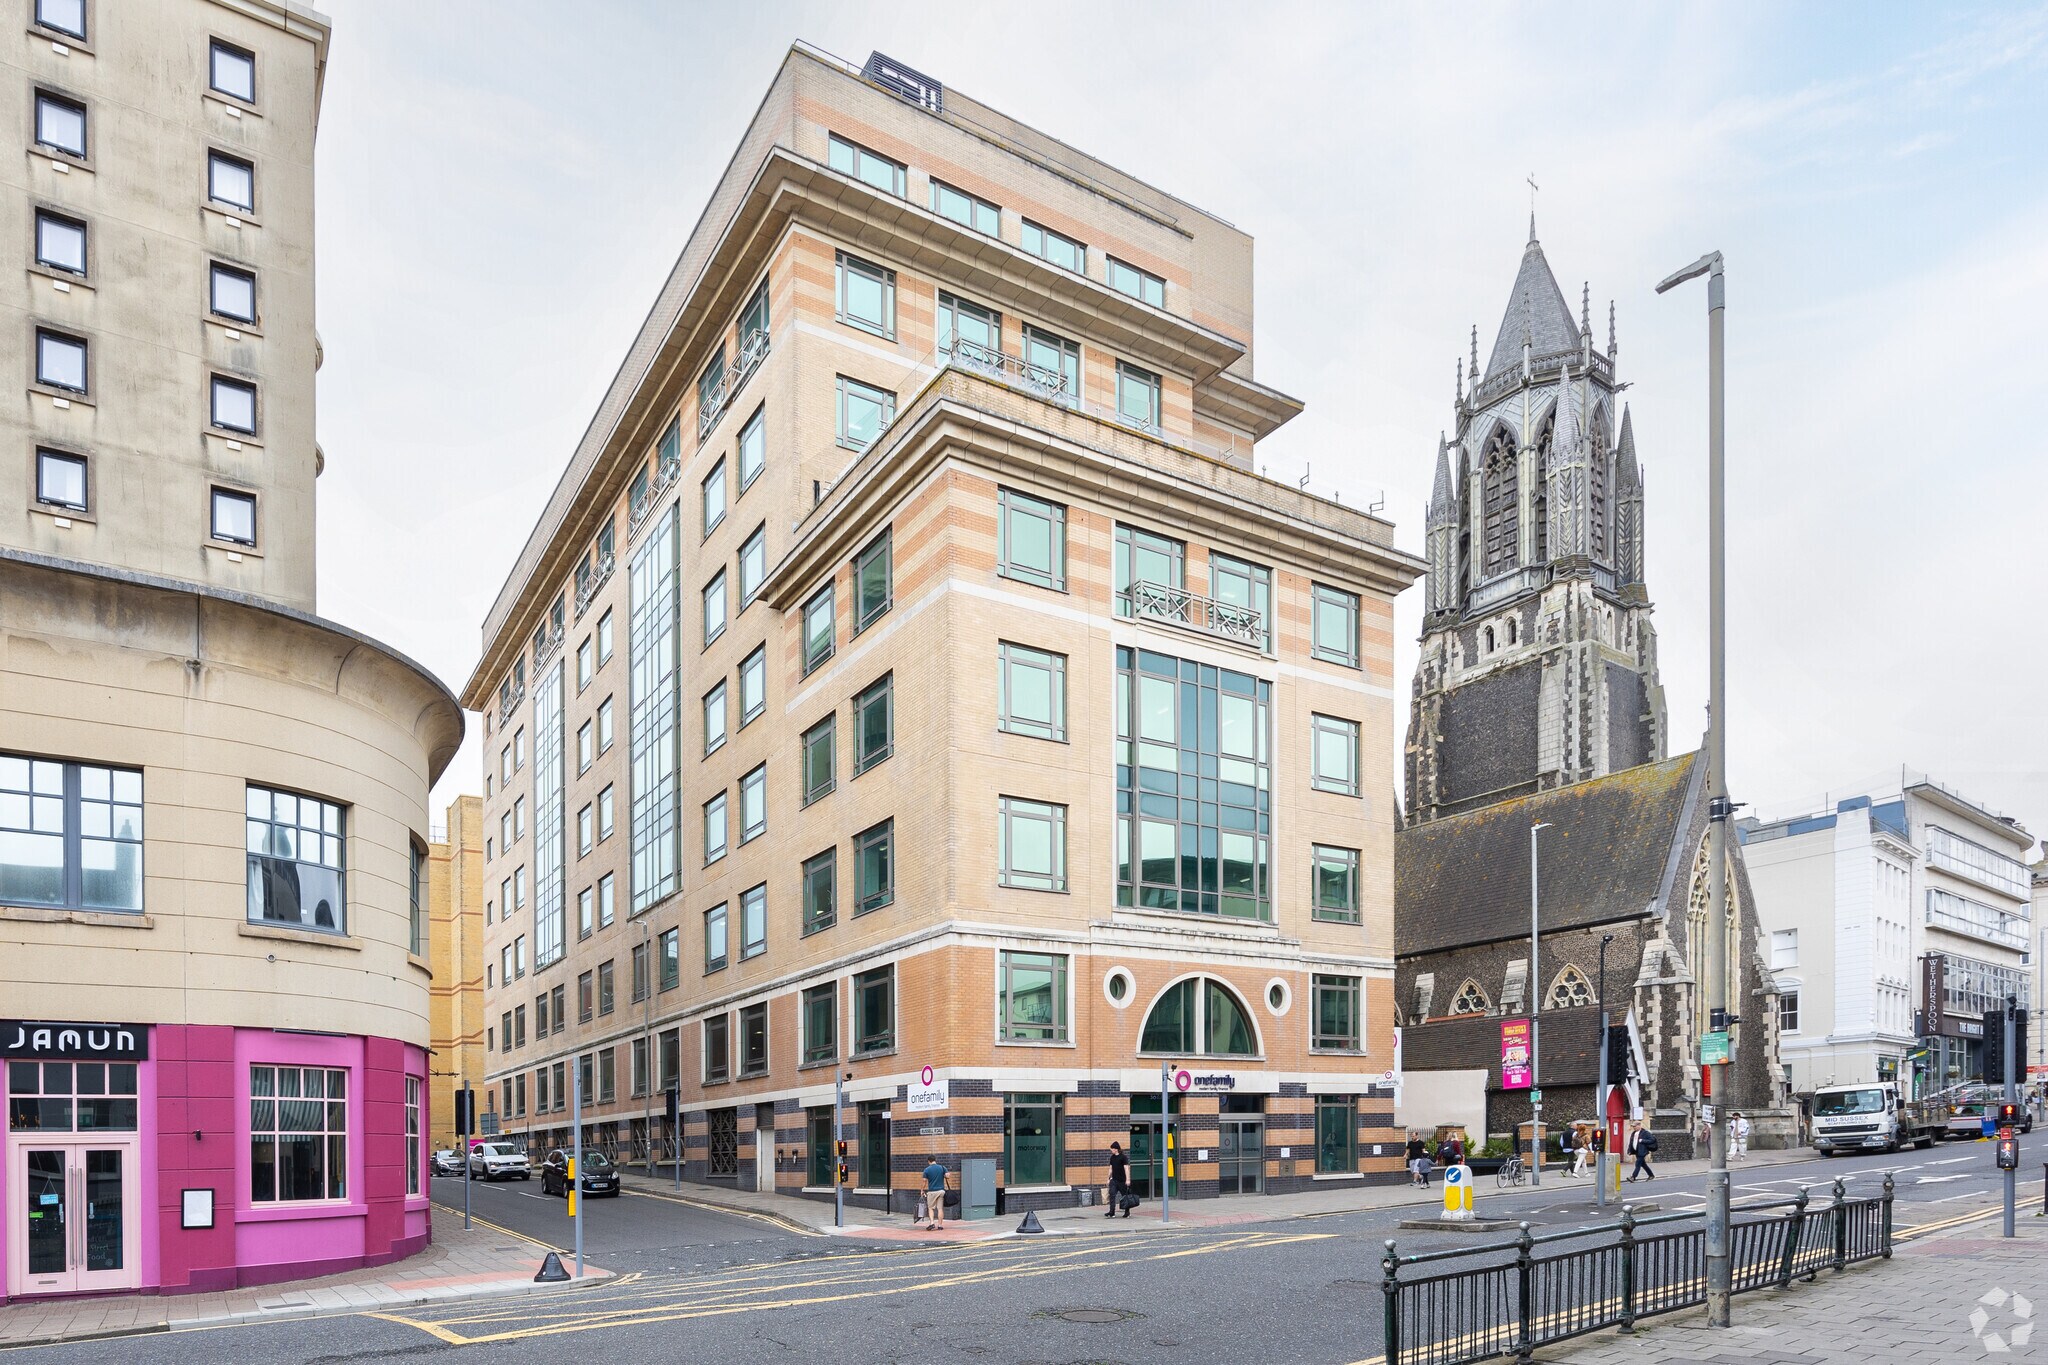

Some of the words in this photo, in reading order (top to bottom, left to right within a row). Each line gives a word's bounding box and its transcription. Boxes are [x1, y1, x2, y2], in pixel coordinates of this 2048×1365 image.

[1927, 959, 1939, 1032] WETHERSPOON
[8, 1027, 134, 1052] JAMUN
[1194, 1074, 1235, 1089] onefamily
[911, 1090, 945, 1104] onefamily
[1017, 1145, 1048, 1153] motorway
